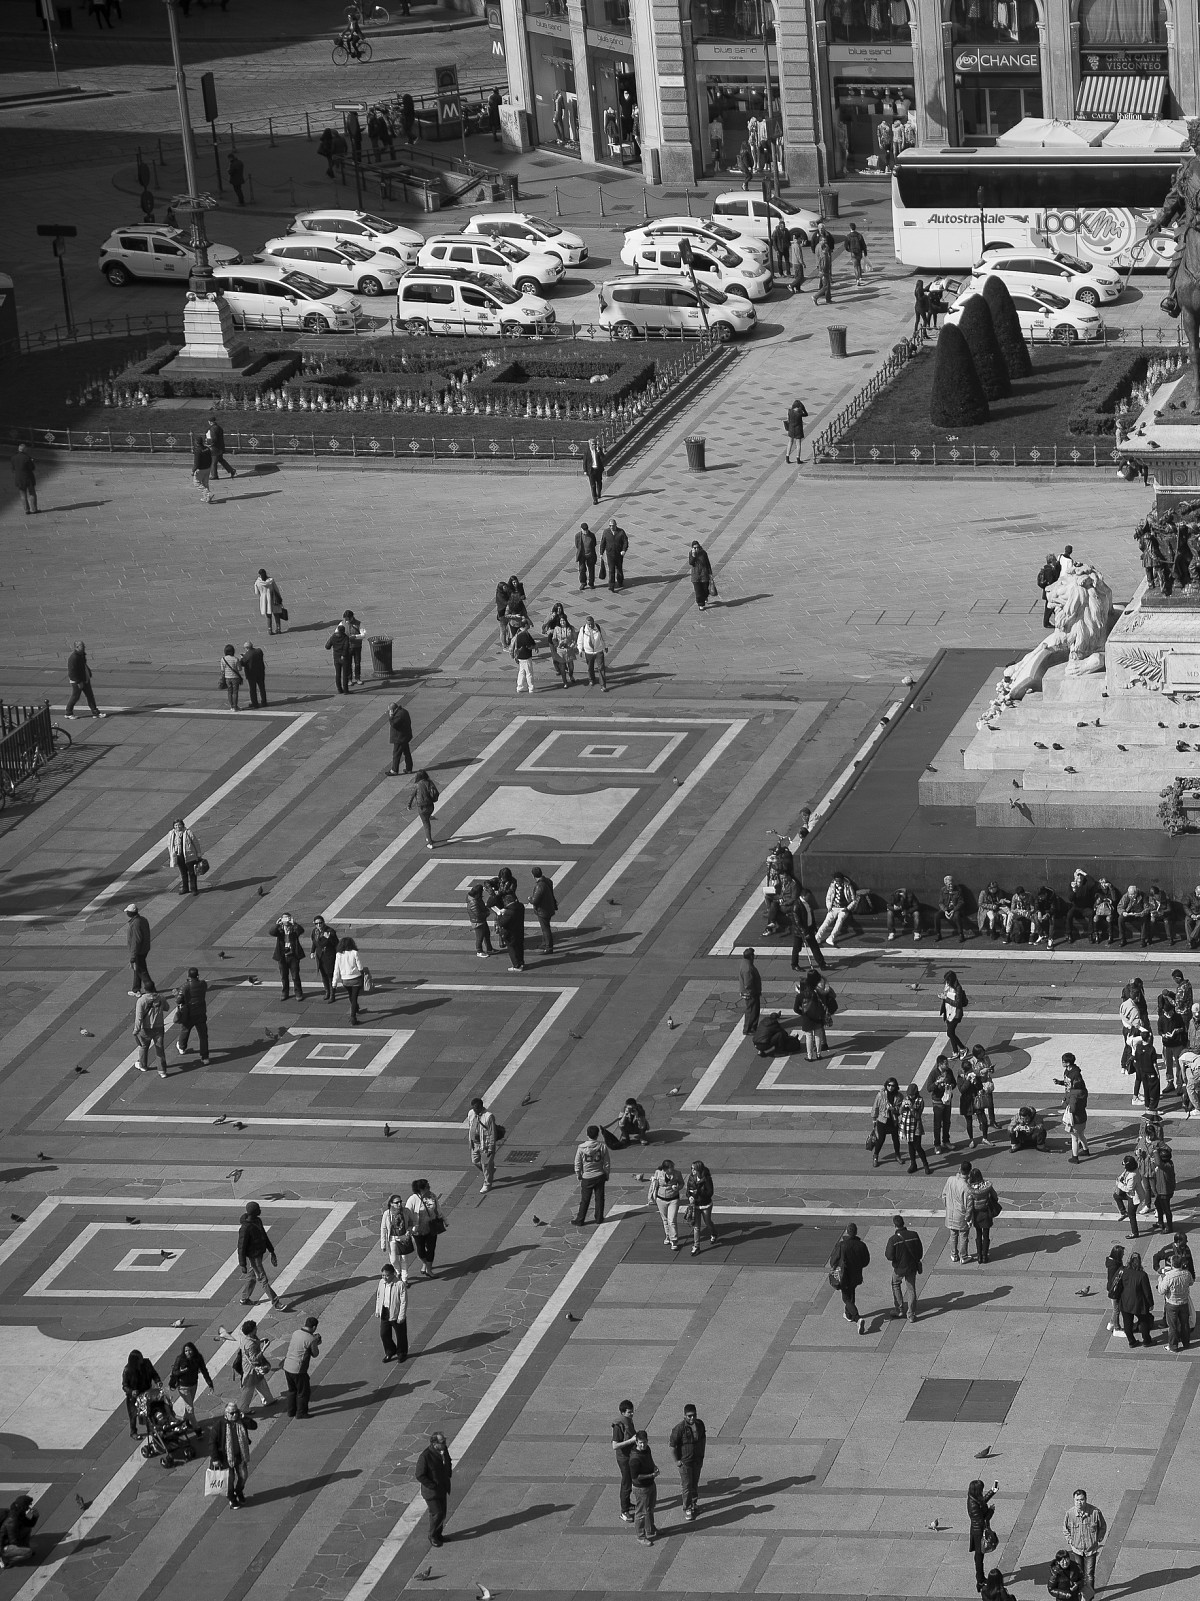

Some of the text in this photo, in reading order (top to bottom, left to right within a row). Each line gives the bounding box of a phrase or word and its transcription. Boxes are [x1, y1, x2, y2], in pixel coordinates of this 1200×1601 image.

[492, 41, 504, 56] M
[714, 46, 757, 54] blue sand
[848, 47, 892, 56] blue sand
[980, 54, 1038, 67] CHANGE
[1106, 62, 1161, 70] VISCONTEO
[443, 102, 459, 119] M
[927, 213, 1006, 224] Autostradale
[1035, 210, 1095, 235] LOOK
